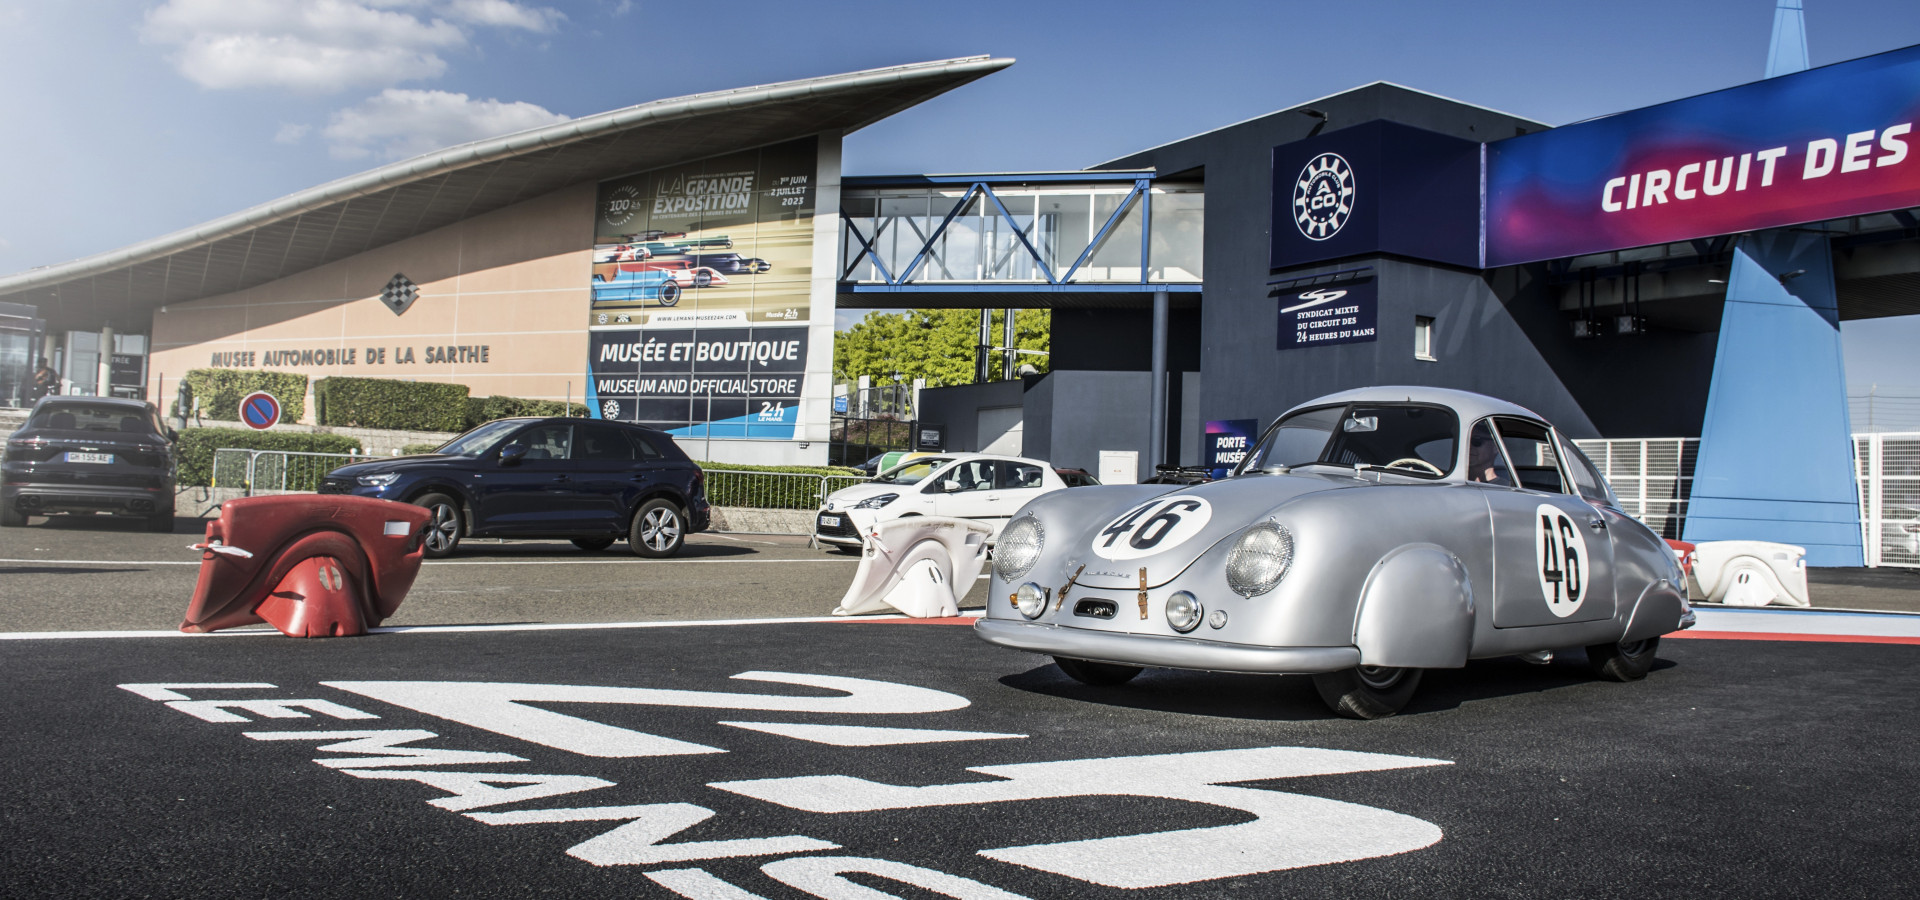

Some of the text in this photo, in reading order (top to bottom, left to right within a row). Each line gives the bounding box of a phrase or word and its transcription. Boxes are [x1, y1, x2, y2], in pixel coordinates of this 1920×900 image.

[1601, 122, 1913, 213] CIRCUIT DES
[656, 172, 754, 198] LA GRANDE
[790, 176, 808, 186] JUIN
[1306, 172, 1341, 195] AUTOMOBILE CLUB
[771, 188, 776, 196] 2
[776, 186, 807, 197] JUILLET
[610, 199, 630, 212] 100
[654, 192, 751, 214] EXPOSITION
[782, 197, 804, 206] 2023
[1297, 306, 1359, 320] SYNDICAT MIXTE
[1309, 319, 1340, 328] CIRCUIT
[1342, 317, 1357, 325] DES
[1297, 331, 1308, 343] 24
[1309, 331, 1338, 341] HEURES
[1352, 328, 1375, 337] MANS
[210, 345, 490, 367] MUSEE AUTOMOBILE DE LA SARTHE
[600, 337, 800, 366] MUSÉE ET BOUTIQUE
[111, 356, 130, 364] TRÉE
[598, 379, 796, 394] MUSEUM AND OFFICIAL STORE
[759, 401, 784, 417] 24h
[1216, 436, 1246, 448] PORTE
[1102, 500, 1202, 550] 46
[1541, 514, 1580, 604] 46
[116, 682, 381, 723] LE
